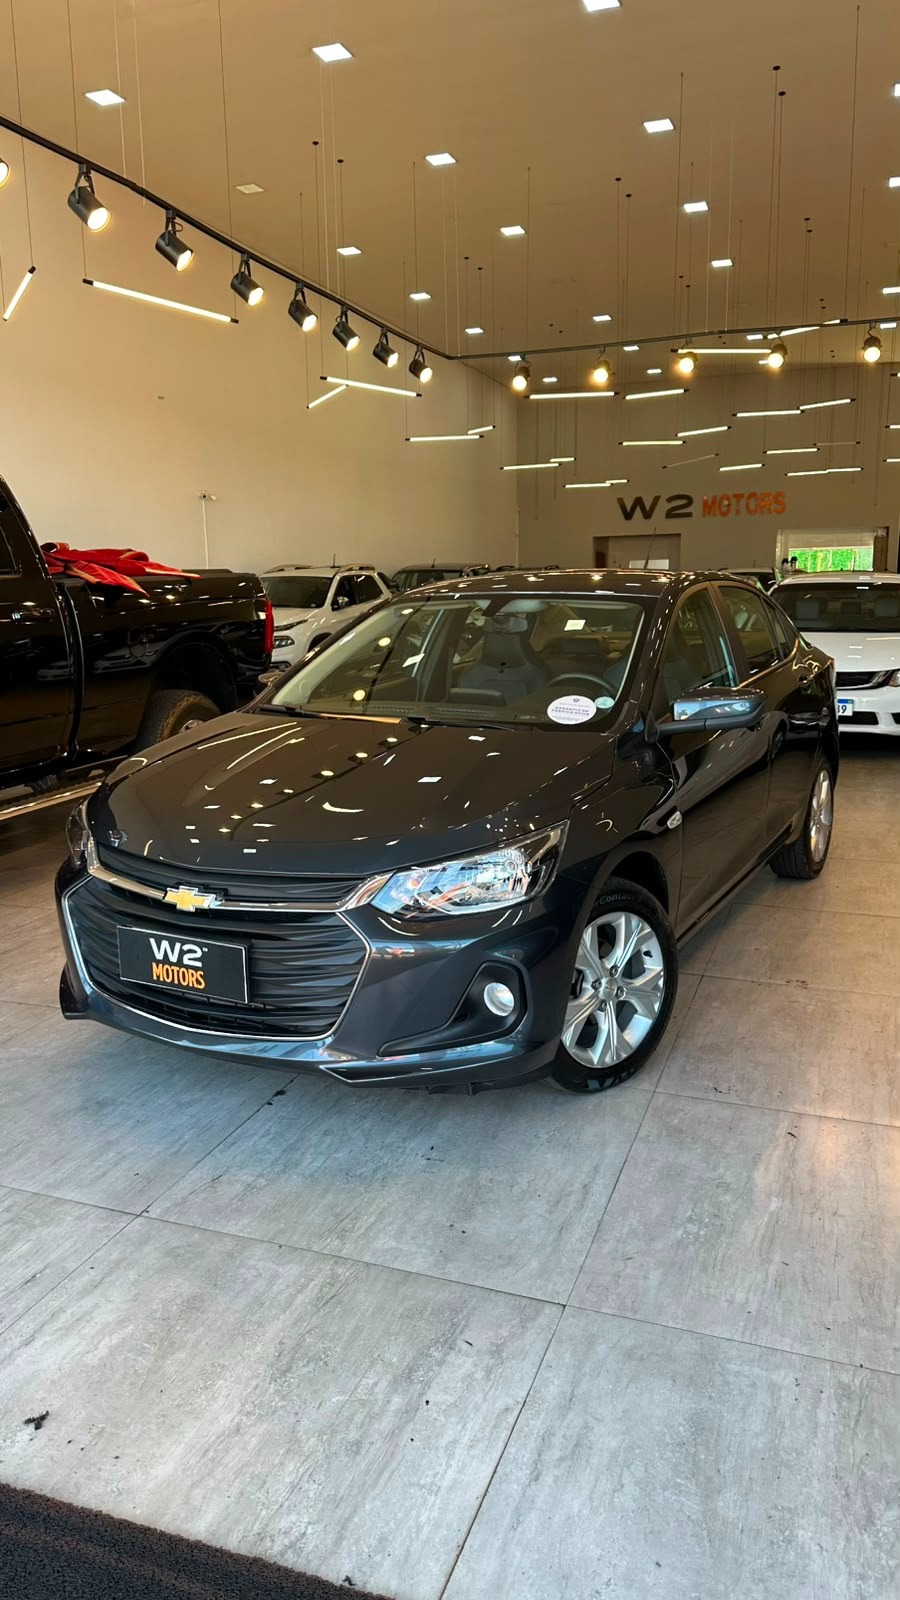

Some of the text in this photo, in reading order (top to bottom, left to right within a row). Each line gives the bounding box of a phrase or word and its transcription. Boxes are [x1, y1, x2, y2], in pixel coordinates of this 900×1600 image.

[616, 491, 787, 521] W2 MOTORS
[151, 962, 205, 989] MOTORS
